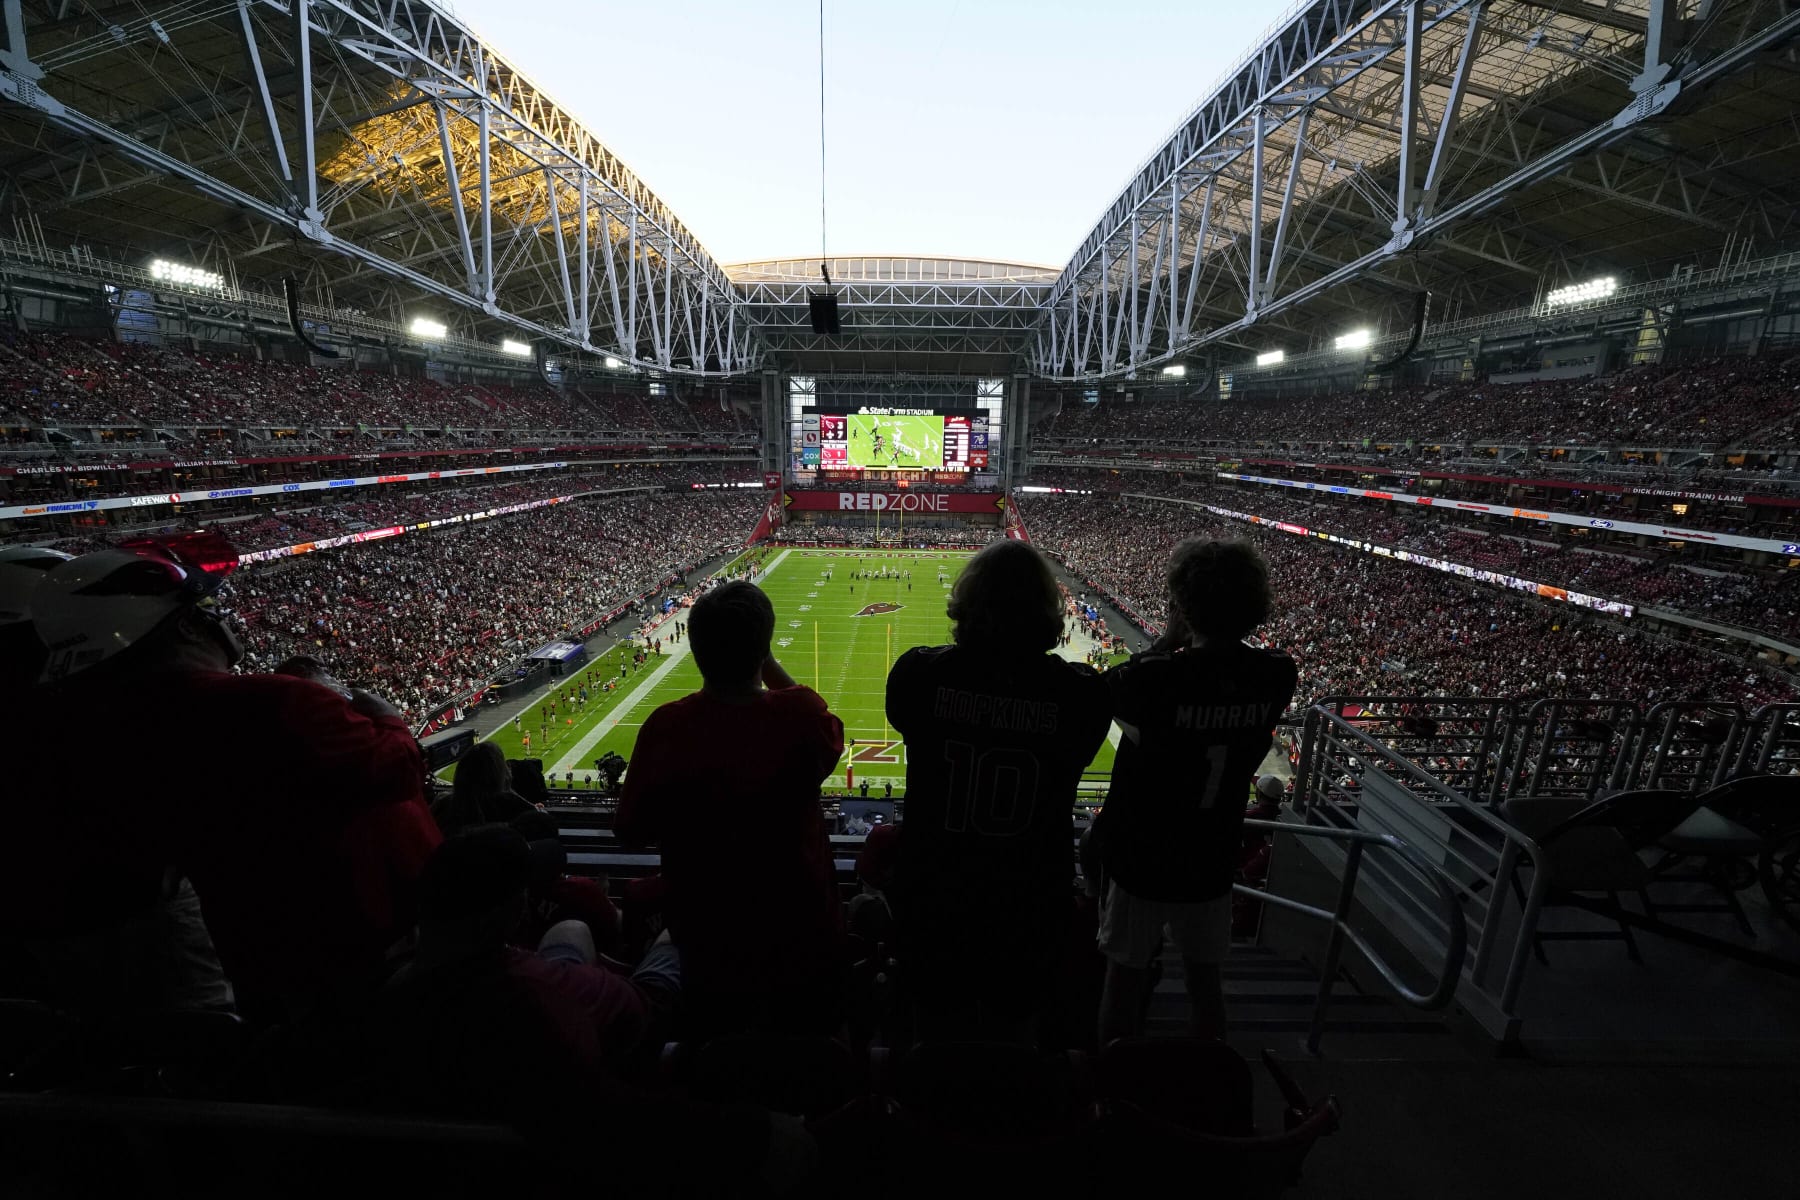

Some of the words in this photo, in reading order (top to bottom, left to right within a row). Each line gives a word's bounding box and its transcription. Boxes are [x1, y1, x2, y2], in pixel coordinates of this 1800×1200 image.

[906, 408, 934, 416] STADIUM
[837, 421, 844, 429] 3
[837, 430, 844, 439] 7
[16, 466, 61, 474] CHARLES
[825, 471, 857, 479] REDZONE
[863, 471, 889, 481] BUD
[891, 471, 928, 481] LIGHT
[221, 488, 253, 497] HYUNDAI
[283, 484, 300, 492] COX
[130, 496, 170, 506] SAFEWAY
[1652, 489, 1682, 497] (NIGHT
[1684, 491, 1716, 499] TRAIN)
[1717, 494, 1745, 503] LANE
[839, 493, 949, 511] REDZONE
[934, 686, 1060, 735] HOPKINS
[1175, 702, 1272, 729] MURRAY
[1199, 745, 1228, 809] 1
[944, 739, 1040, 836] 10
